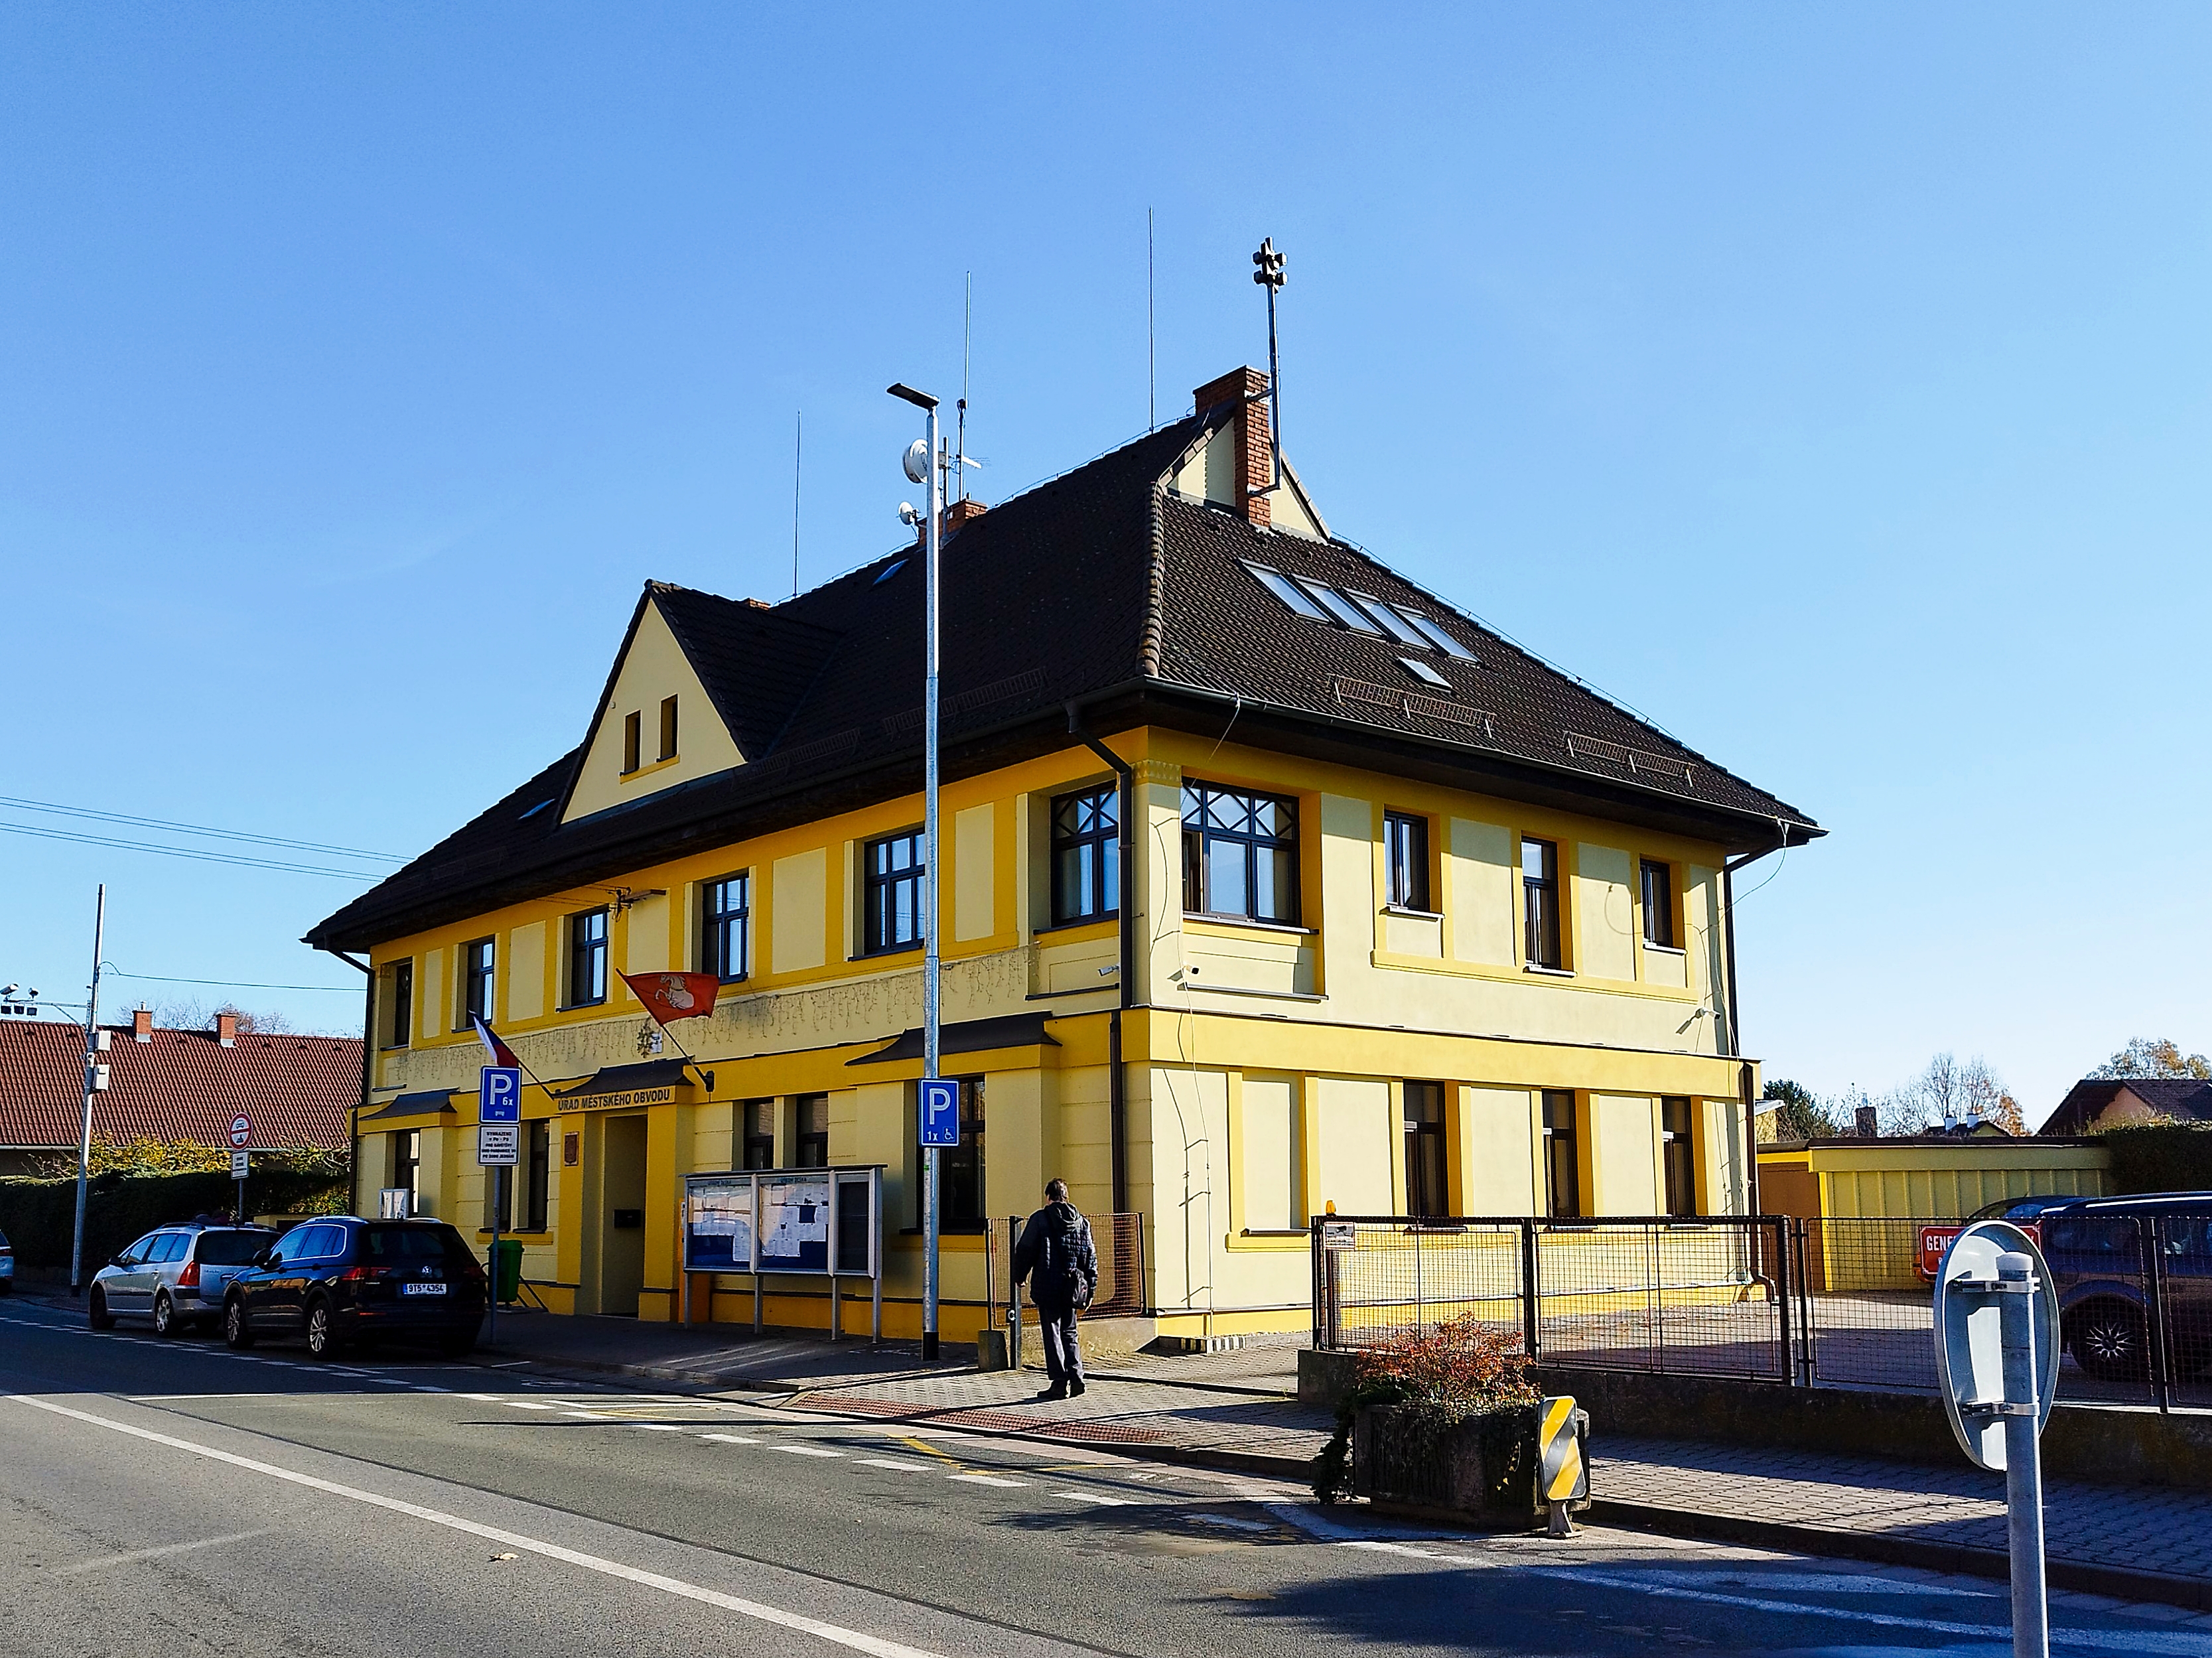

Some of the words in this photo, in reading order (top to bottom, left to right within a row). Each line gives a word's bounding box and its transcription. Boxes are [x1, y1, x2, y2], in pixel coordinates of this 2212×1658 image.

[490, 1074, 512, 1105] P
[582, 1092, 631, 1109] MĚSTSKÉHO
[634, 1089, 670, 1104] OBVODU
[502, 1097, 514, 1106] 6x
[930, 1088, 951, 1125] P
[927, 1131, 938, 1141] 1x
